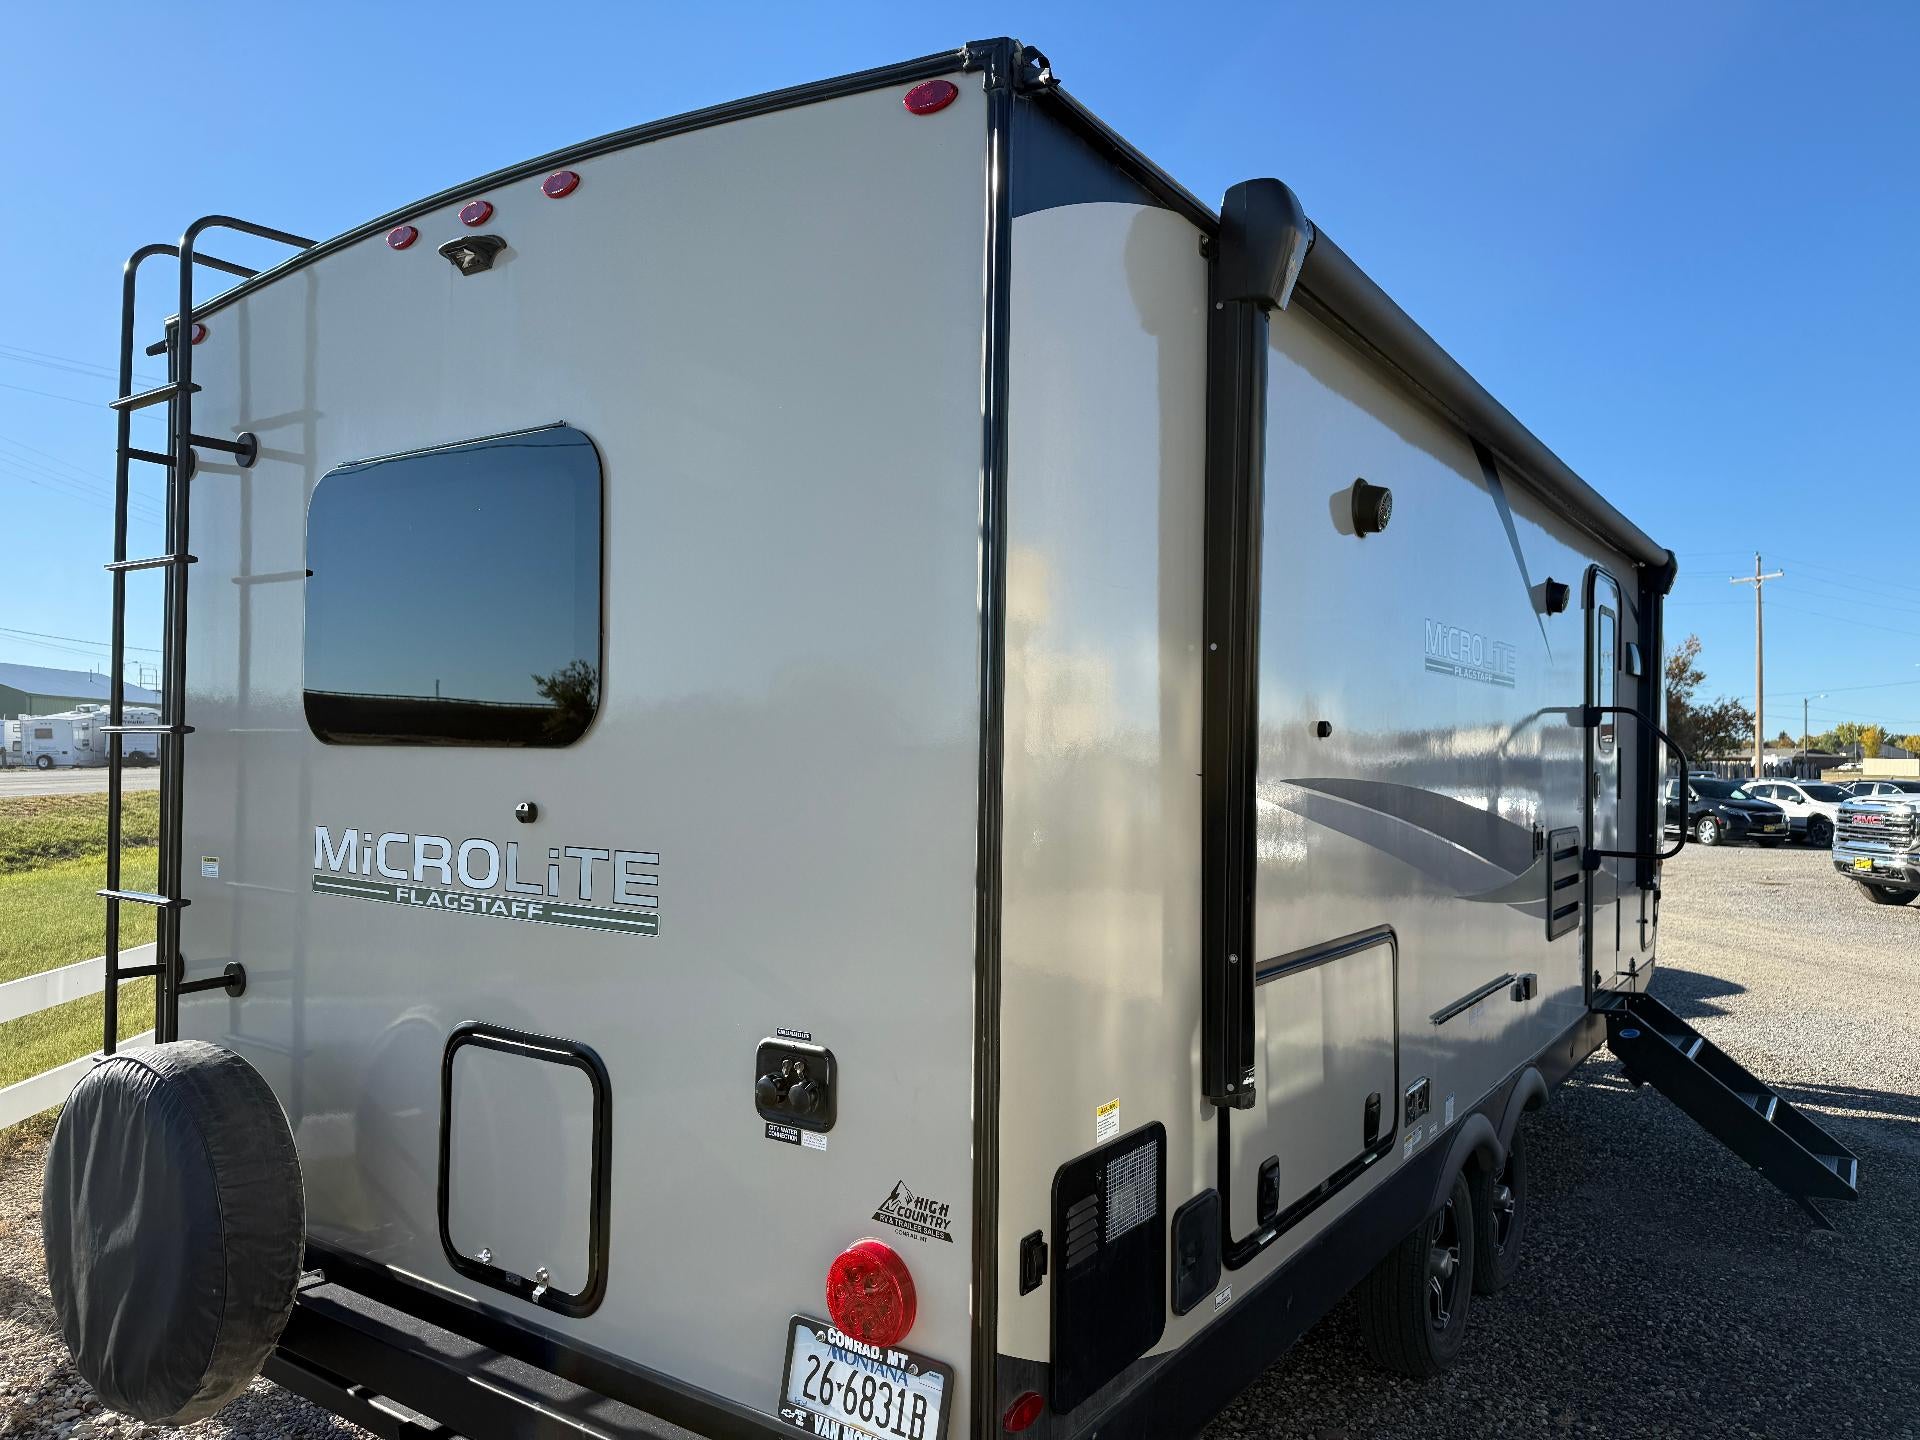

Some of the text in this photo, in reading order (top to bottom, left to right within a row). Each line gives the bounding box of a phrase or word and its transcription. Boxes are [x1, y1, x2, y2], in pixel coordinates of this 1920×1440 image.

[1454, 666, 1494, 682] FLAGSTAFF
[395, 886, 544, 919] FLAGSTAFF
[768, 1124, 798, 1136] CITY WATER
[768, 1130, 798, 1142] CONNECTION
[897, 1205, 952, 1230] COUNTRY
[914, 1196, 950, 1218] HIGH
[894, 1219, 922, 1233] TRAILER
[923, 1228, 945, 1239] SALES
[826, 1346, 909, 1387] MONTANA
[887, 1351, 910, 1369] MT
[814, 1413, 841, 1440] VAN
